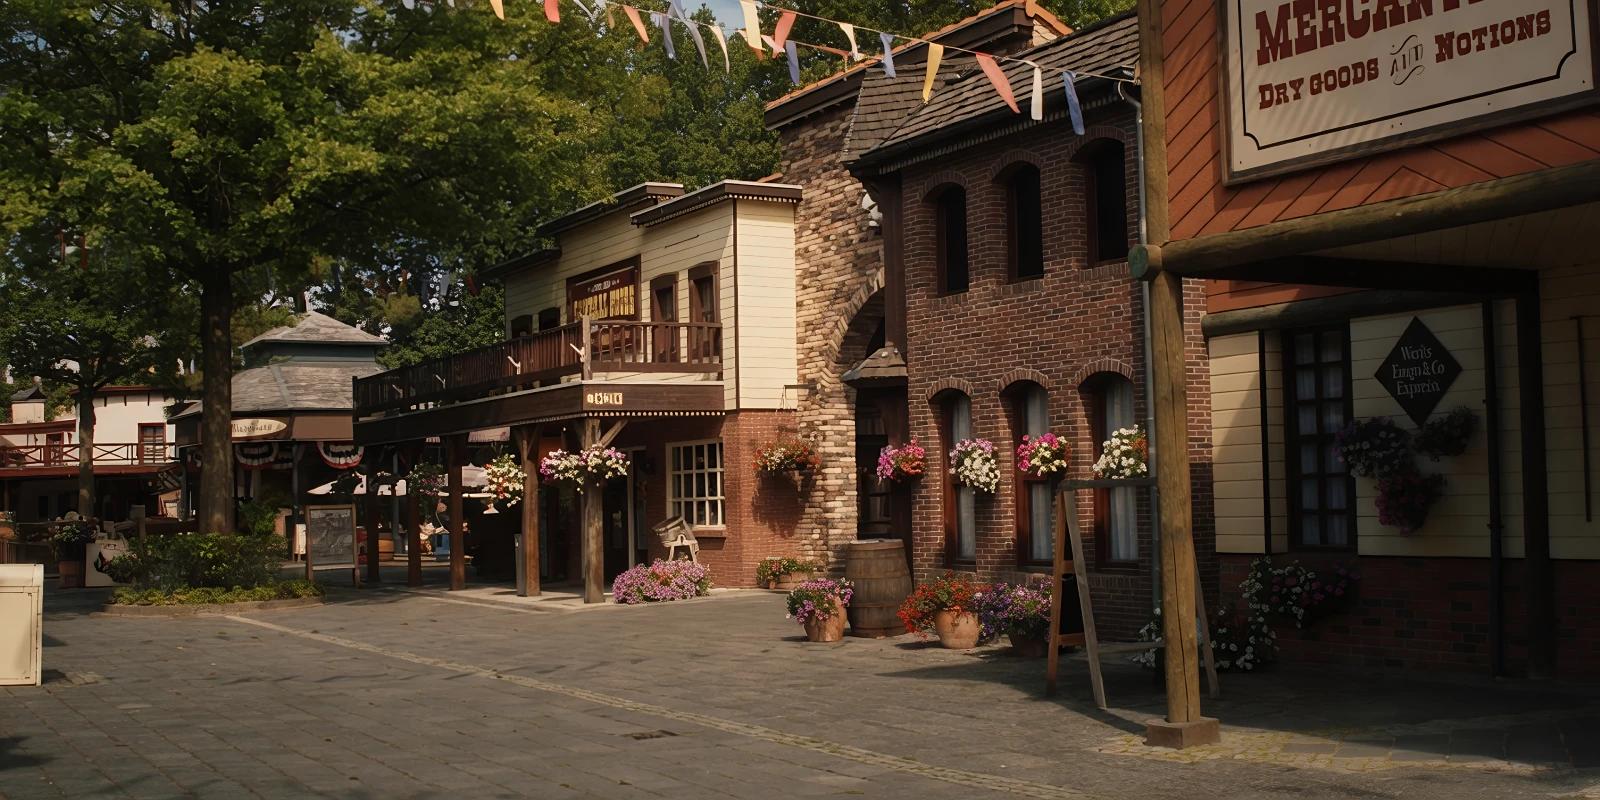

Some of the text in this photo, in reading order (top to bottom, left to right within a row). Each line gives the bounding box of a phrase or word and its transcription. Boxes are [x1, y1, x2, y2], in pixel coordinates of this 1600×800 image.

[1255, 0, 1482, 67] MERCA
[1258, 77, 1305, 111] DRY
[1309, 57, 1380, 97] GOODS
[1434, 9, 1552, 64] NOTIONS
